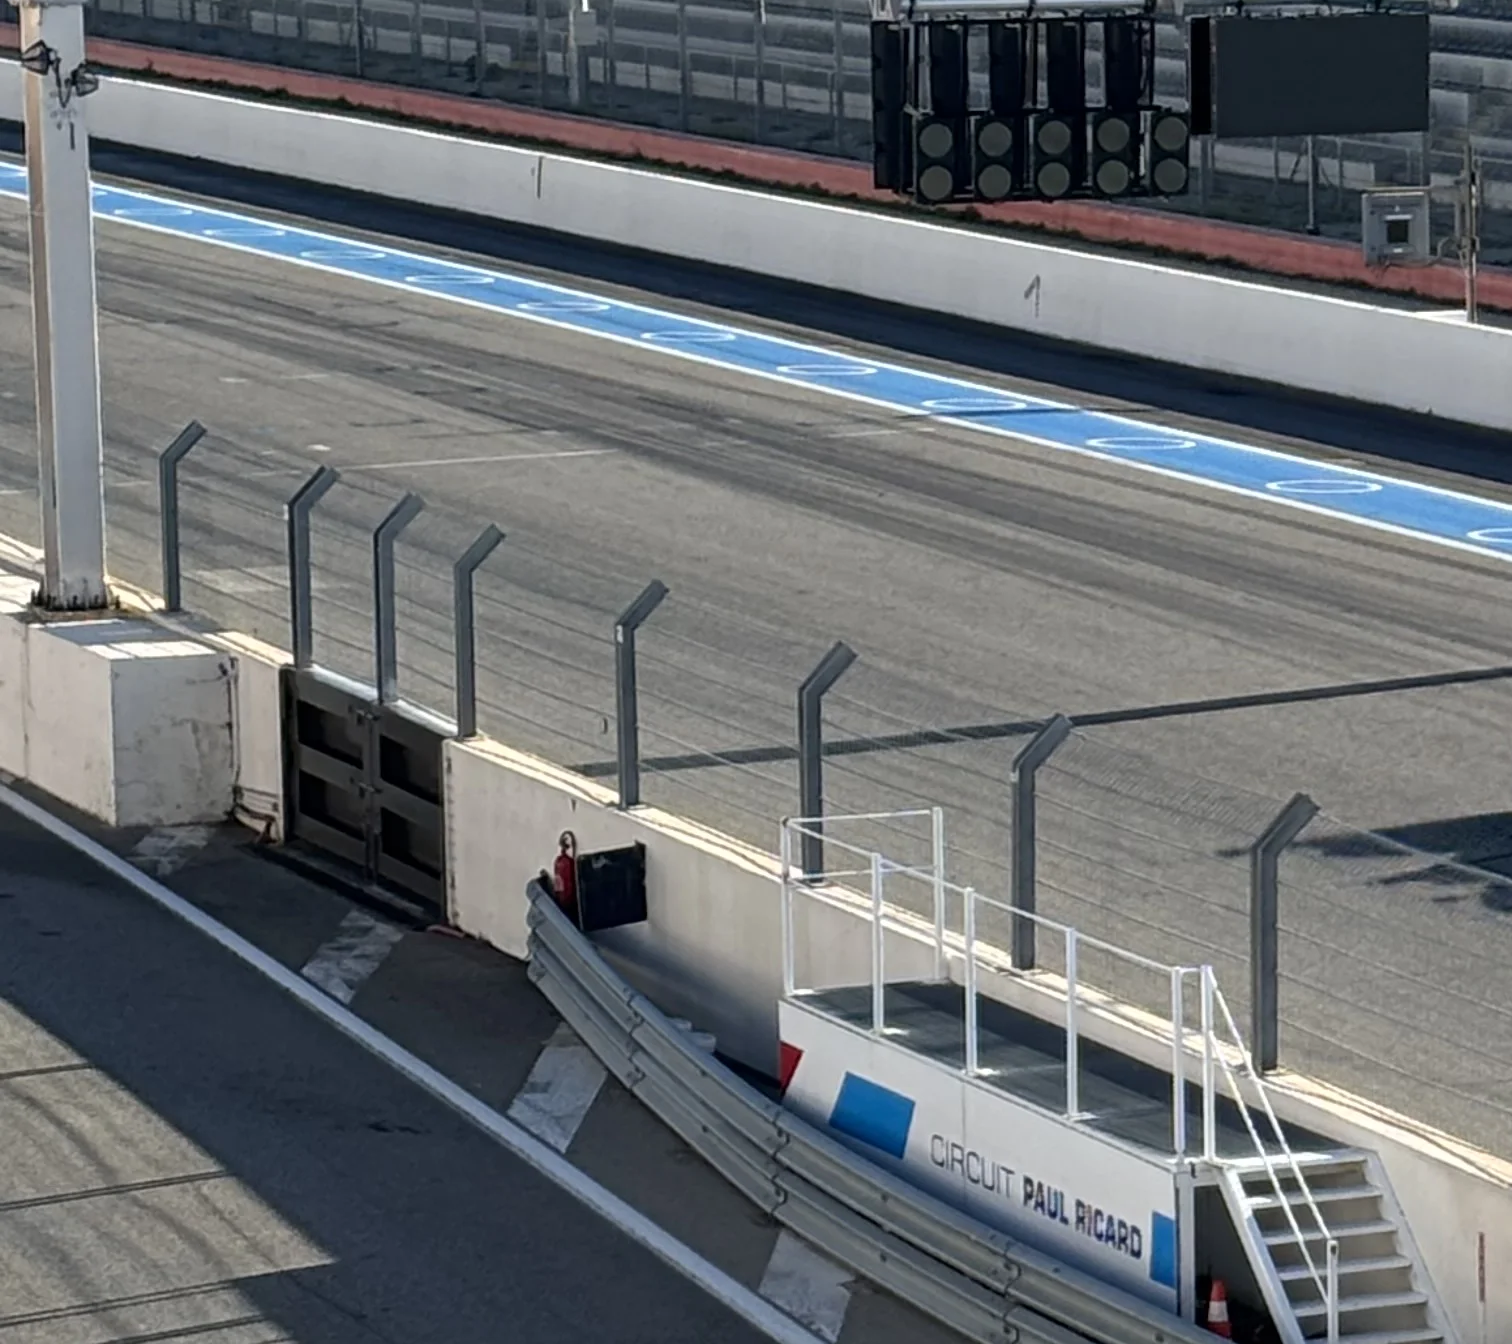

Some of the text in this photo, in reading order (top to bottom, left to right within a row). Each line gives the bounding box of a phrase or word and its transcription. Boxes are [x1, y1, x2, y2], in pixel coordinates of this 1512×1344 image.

[931, 1134, 1142, 1259] CIRCUIT PAUL RICARD
